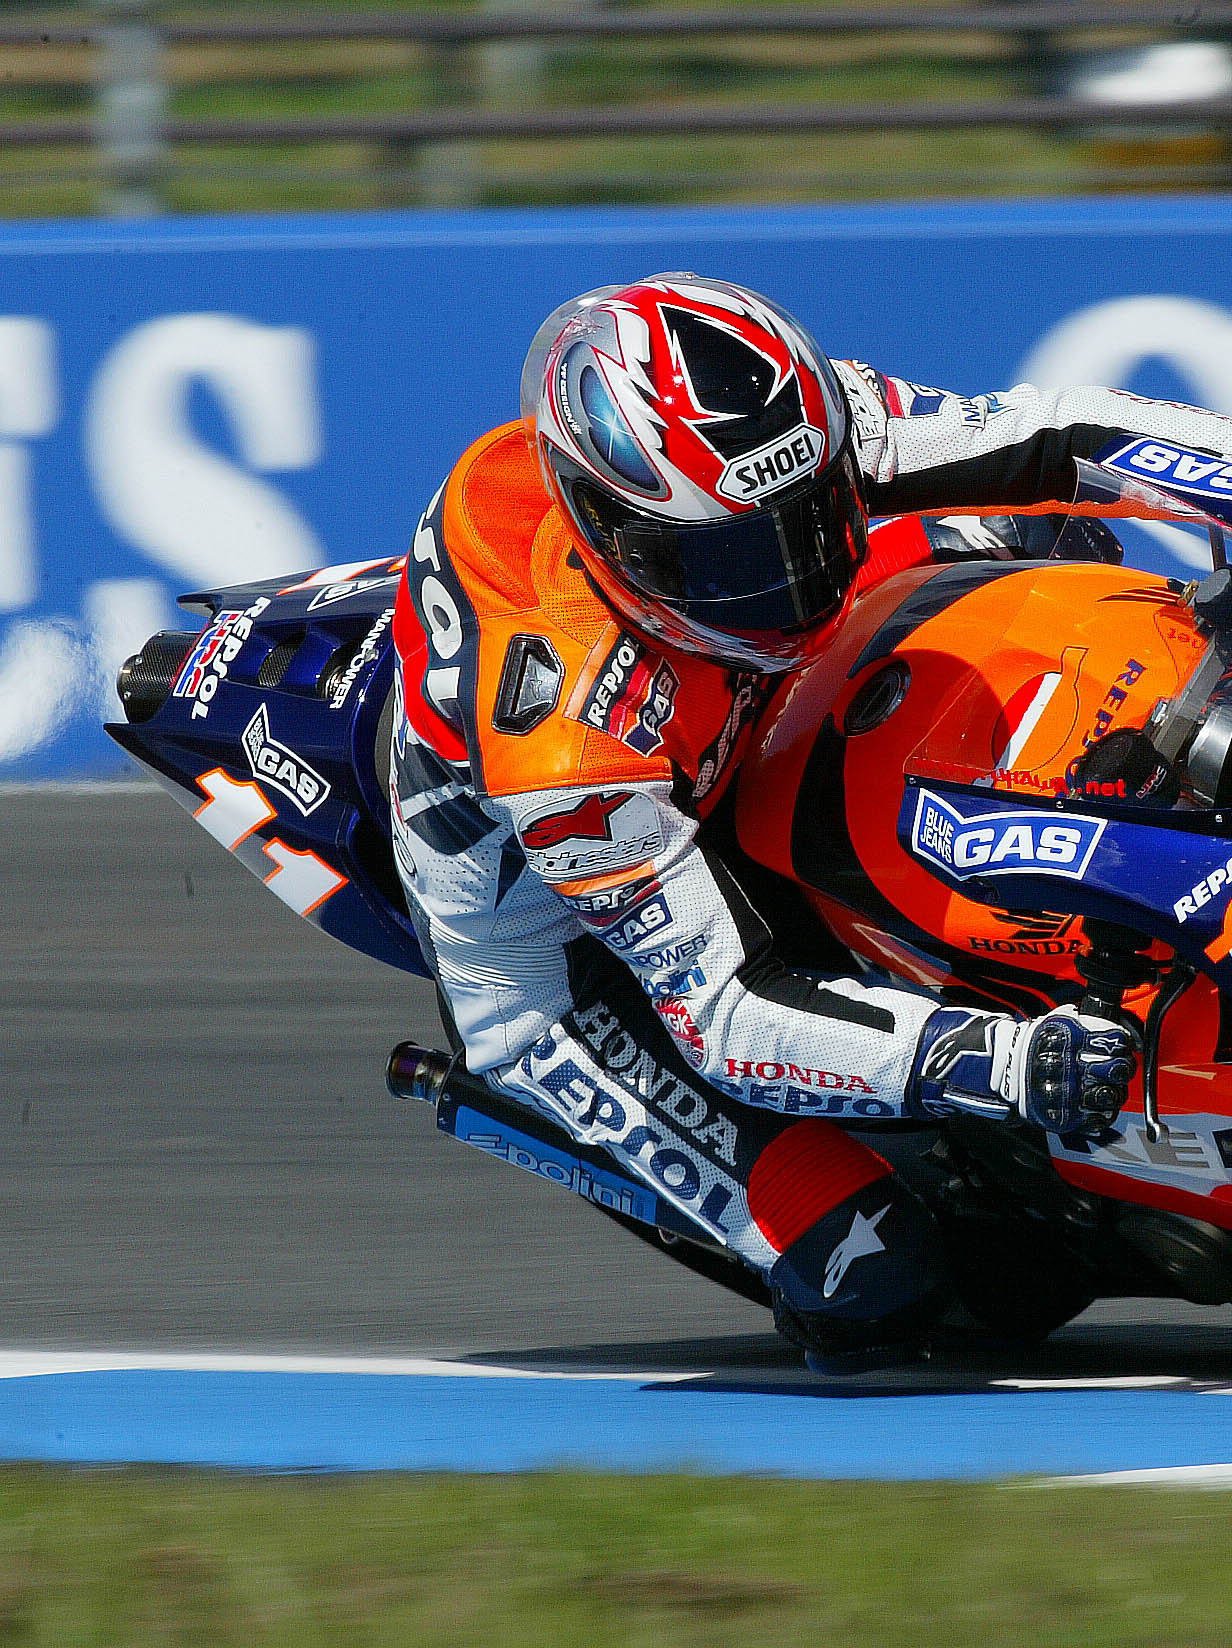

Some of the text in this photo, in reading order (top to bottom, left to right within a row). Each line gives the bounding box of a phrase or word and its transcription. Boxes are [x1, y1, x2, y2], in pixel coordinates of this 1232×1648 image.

[735, 432, 815, 495] SHOEI
[411, 470, 464, 720] SOL
[190, 596, 272, 720] REPSOL
[329, 608, 397, 710] MANPOWER
[257, 746, 320, 804] GAS
[919, 825, 953, 865] JEANS
[925, 806, 955, 845] BLUE
[953, 825, 1082, 868] GAS
[605, 902, 667, 948] GAS
[628, 935, 710, 968] POWER
[573, 1003, 740, 1168] HONDA
[725, 1057, 879, 1095] HONDA
[506, 1141, 635, 1217] polini
